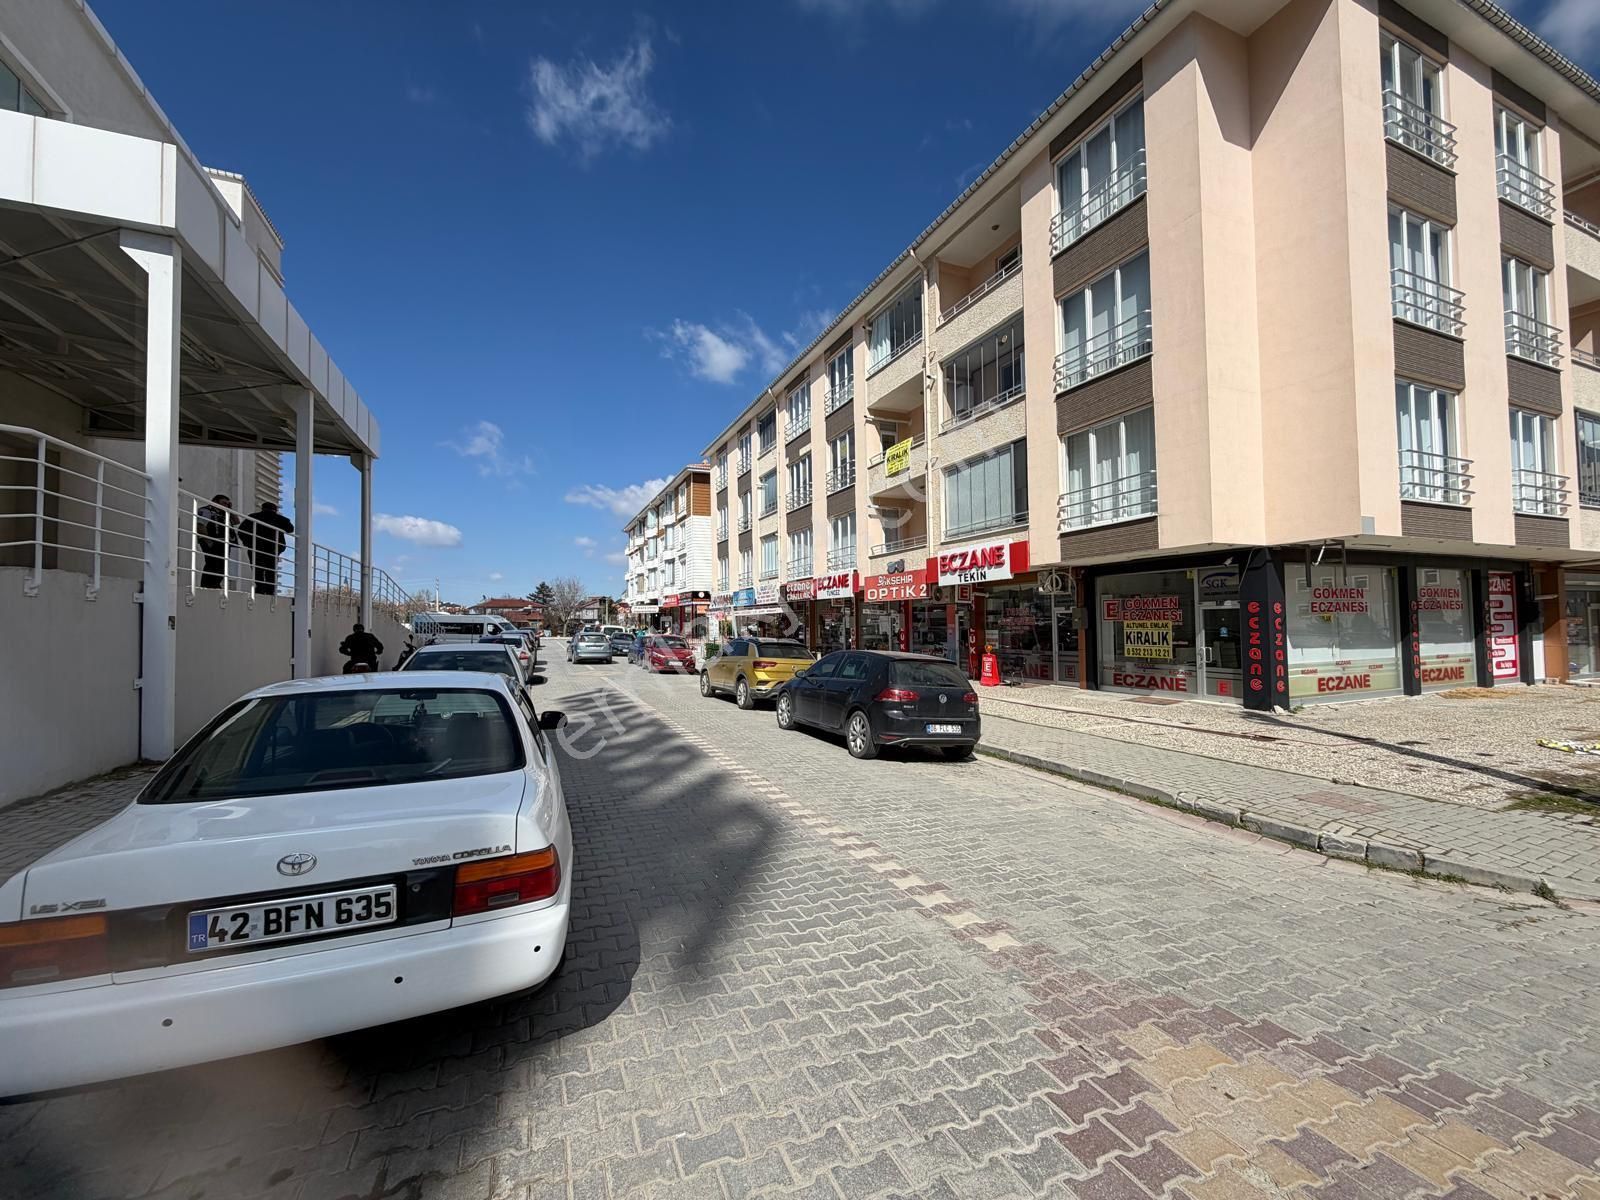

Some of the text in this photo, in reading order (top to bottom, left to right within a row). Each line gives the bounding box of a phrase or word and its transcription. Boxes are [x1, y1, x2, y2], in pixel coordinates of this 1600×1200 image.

[940, 545, 1005, 574] ECZANE
[818, 573, 850, 592] ECZANE
[958, 569, 987, 583] TEKİN
[1206, 578, 1227, 589] SGK
[919, 583, 927, 597] 2
[1488, 578, 1512, 592] CZANE
[1105, 602, 1118, 618] E
[1131, 648, 1141, 656] 532
[1143, 648, 1153, 656] 213
[1155, 648, 1161, 657] 12
[1162, 649, 1170, 657] 21
[1422, 666, 1465, 682] ECZANE
[1113, 673, 1188, 692] ECZANE
[1318, 674, 1371, 692] ECZANE
[412, 845, 512, 866] TOYOTA COROLLA
[191, 892, 392, 944] TR 42 BFN 635
